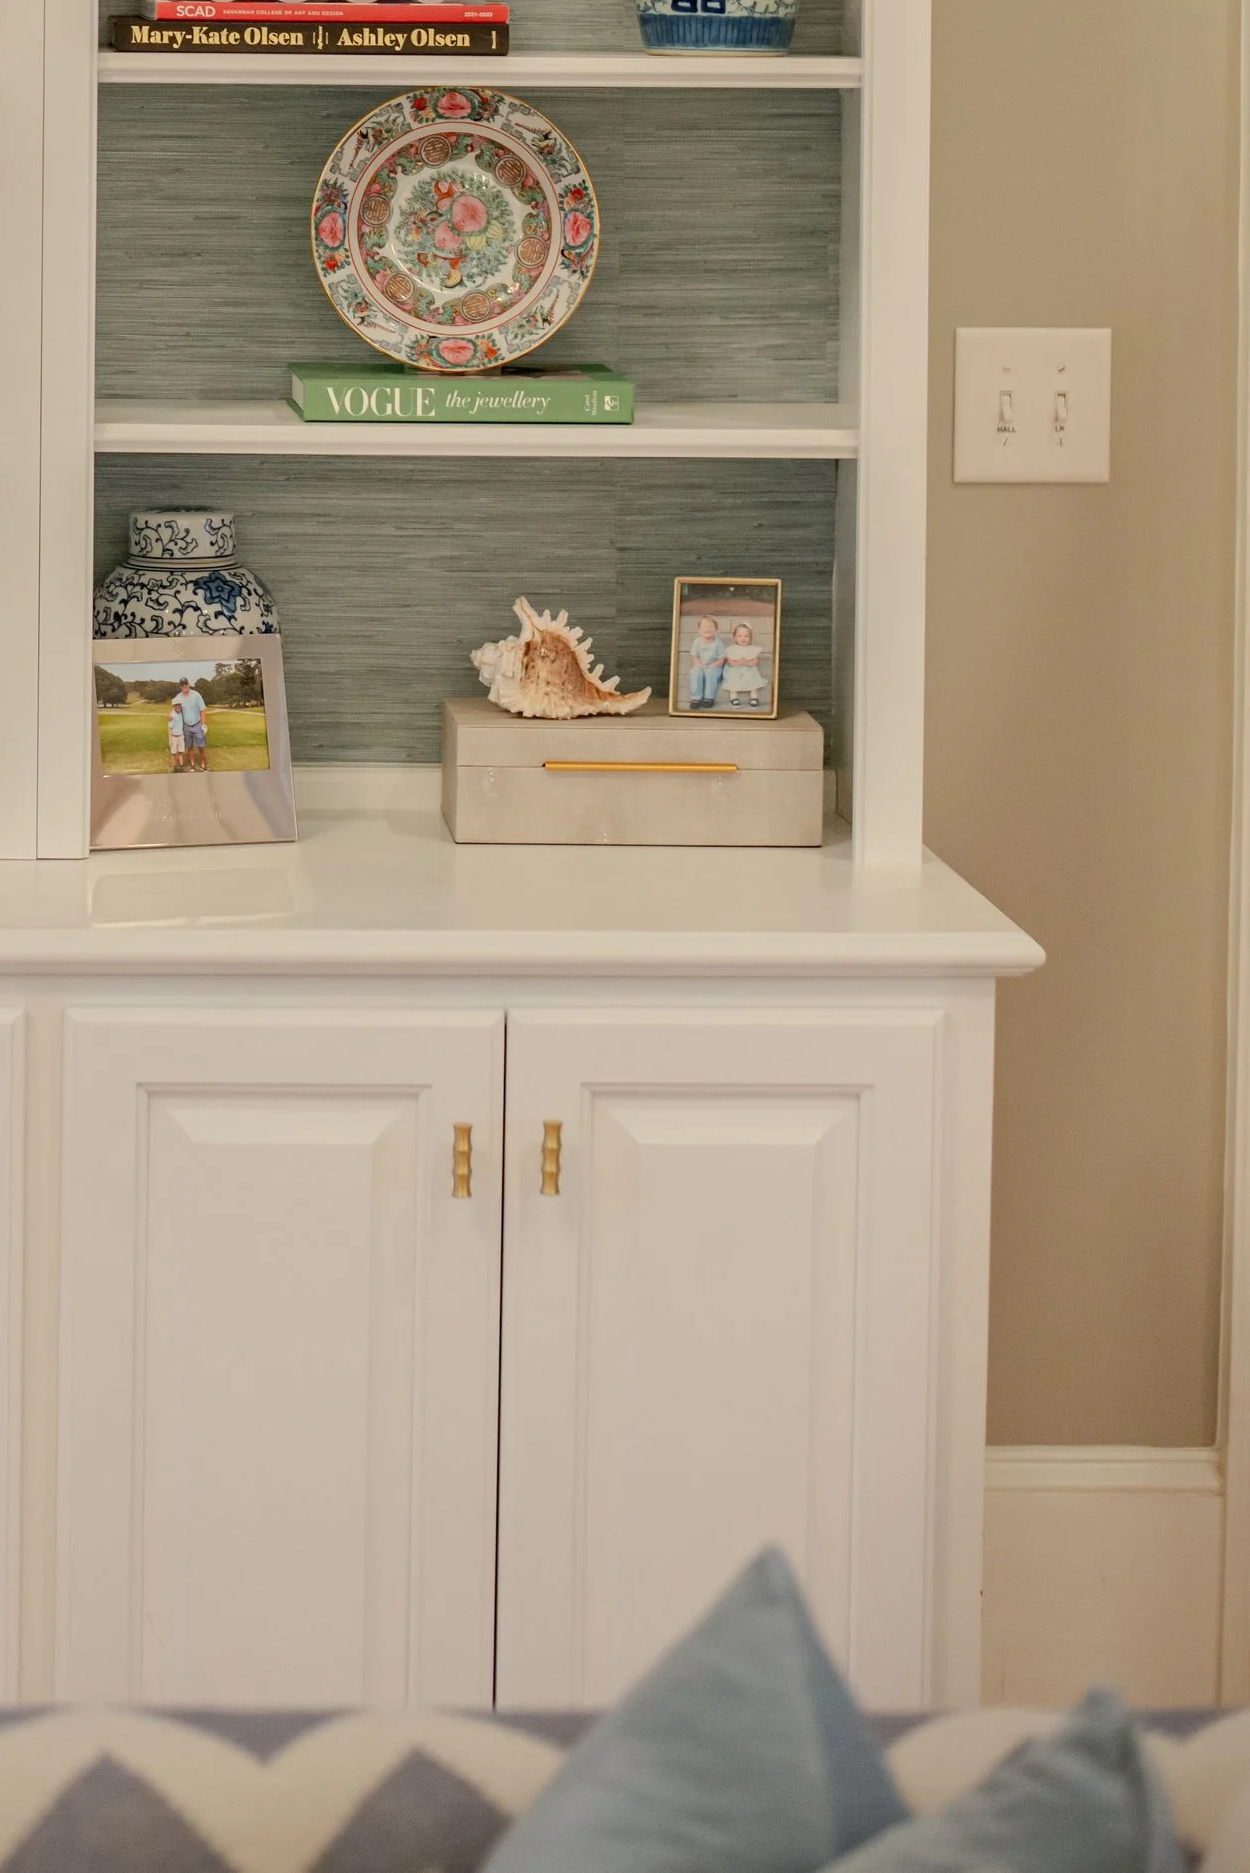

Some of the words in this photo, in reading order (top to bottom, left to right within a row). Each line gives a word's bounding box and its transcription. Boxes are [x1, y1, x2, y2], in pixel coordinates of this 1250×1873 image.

[176, 5, 216, 17] SCAD
[130, 26, 240, 49] Mary-Kate
[244, 27, 304, 45] Olsen
[337, 28, 406, 51] Ashley
[410, 29, 471, 47] Olsen
[326, 387, 436, 417] VOGUE
[445, 390, 470, 408] the
[469, 390, 551, 415] jewellery
